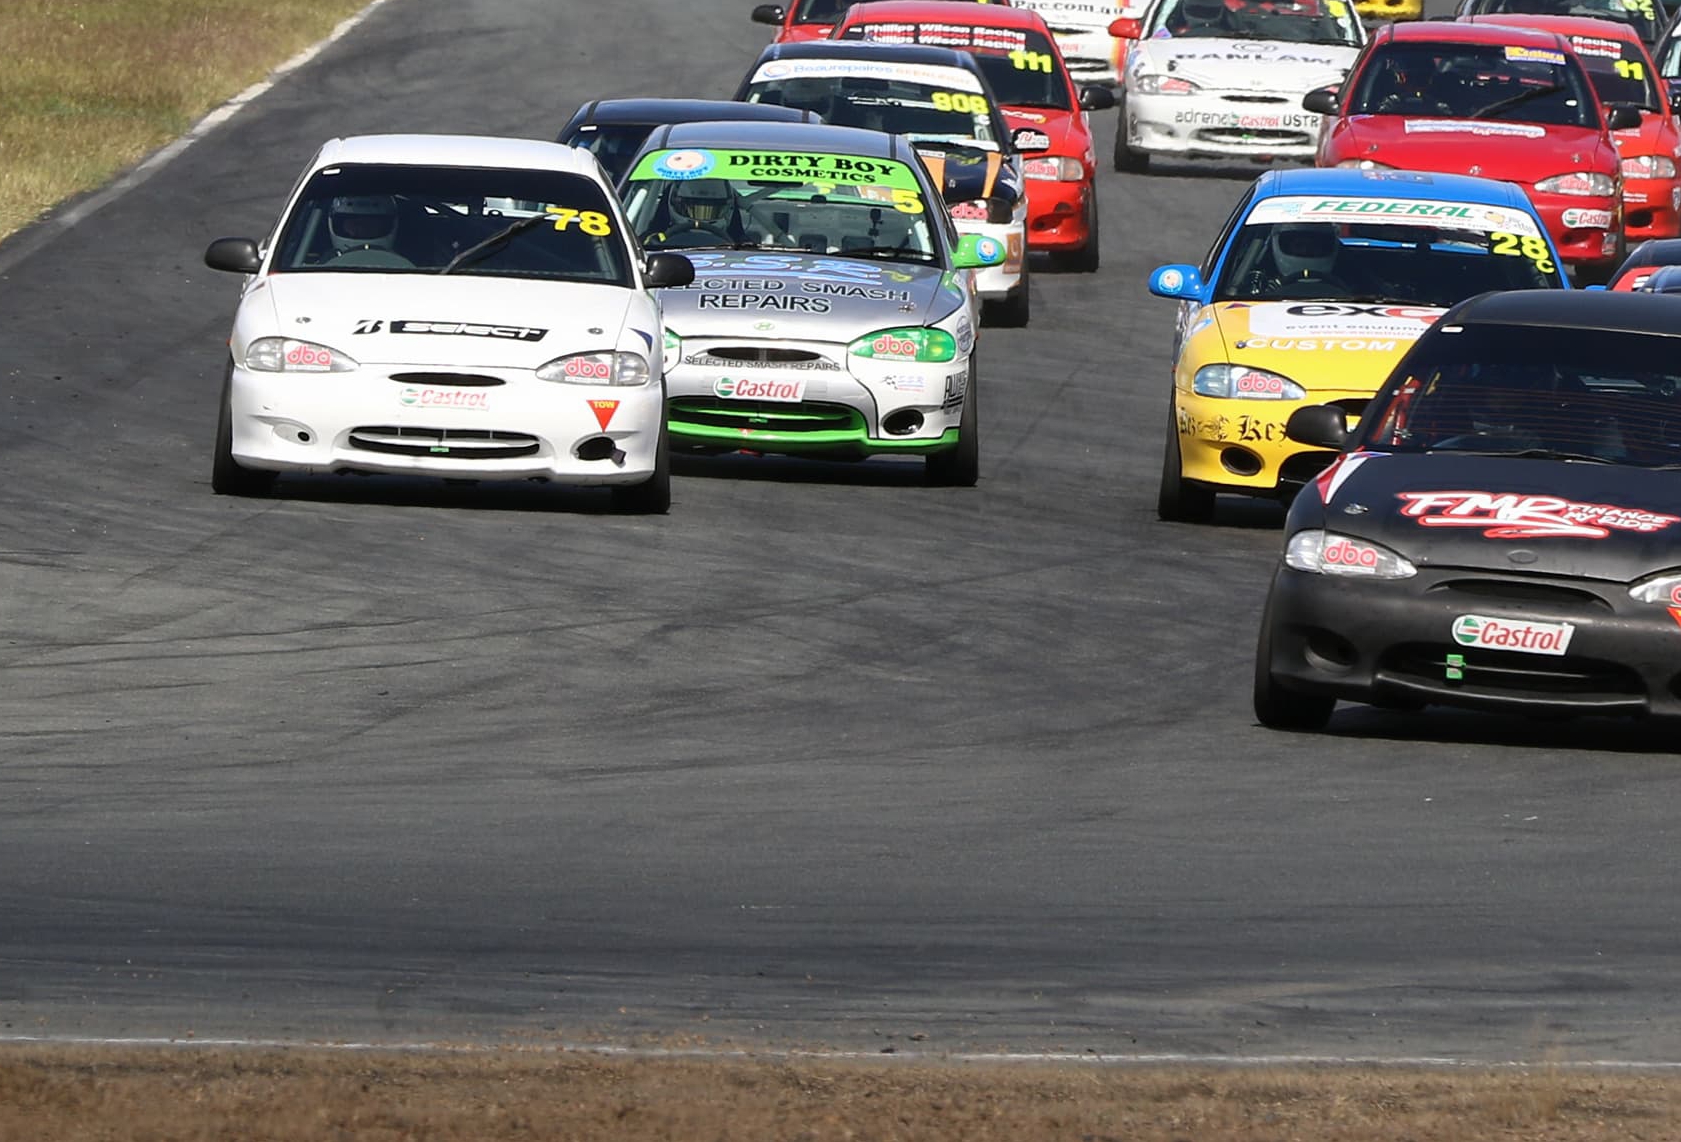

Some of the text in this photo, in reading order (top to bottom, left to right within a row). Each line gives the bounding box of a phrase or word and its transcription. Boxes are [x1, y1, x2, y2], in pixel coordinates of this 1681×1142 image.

[1008, 50, 1053, 73] 111
[1614, 59, 1643, 80] 11
[729, 155, 896, 176] DIRTY BOY
[750, 168, 876, 183] COSMETICS
[891, 189, 924, 214] 5
[1311, 200, 1475, 219] FEDERAL
[545, 206, 611, 236] 78
[1490, 231, 1549, 260] 28
[801, 281, 911, 302] SMASH
[699, 294, 832, 314] REPAIRS
[285, 344, 332, 365] dba
[874, 334, 917, 356] dba
[1245, 339, 1396, 351] CUSTOM
[565, 356, 610, 378] dba
[684, 356, 744, 369] SELECTED
[790, 361, 842, 372] REPAIRS
[735, 379, 801, 399] Castrol
[1238, 373, 1283, 393] dba
[421, 389, 487, 407] Castrol
[593, 401, 615, 409] TOW
[1397, 491, 1578, 528] FMR
[1562, 511, 1596, 522] MY
[1324, 540, 1378, 567] dba
[1481, 622, 1565, 651] Castrol
